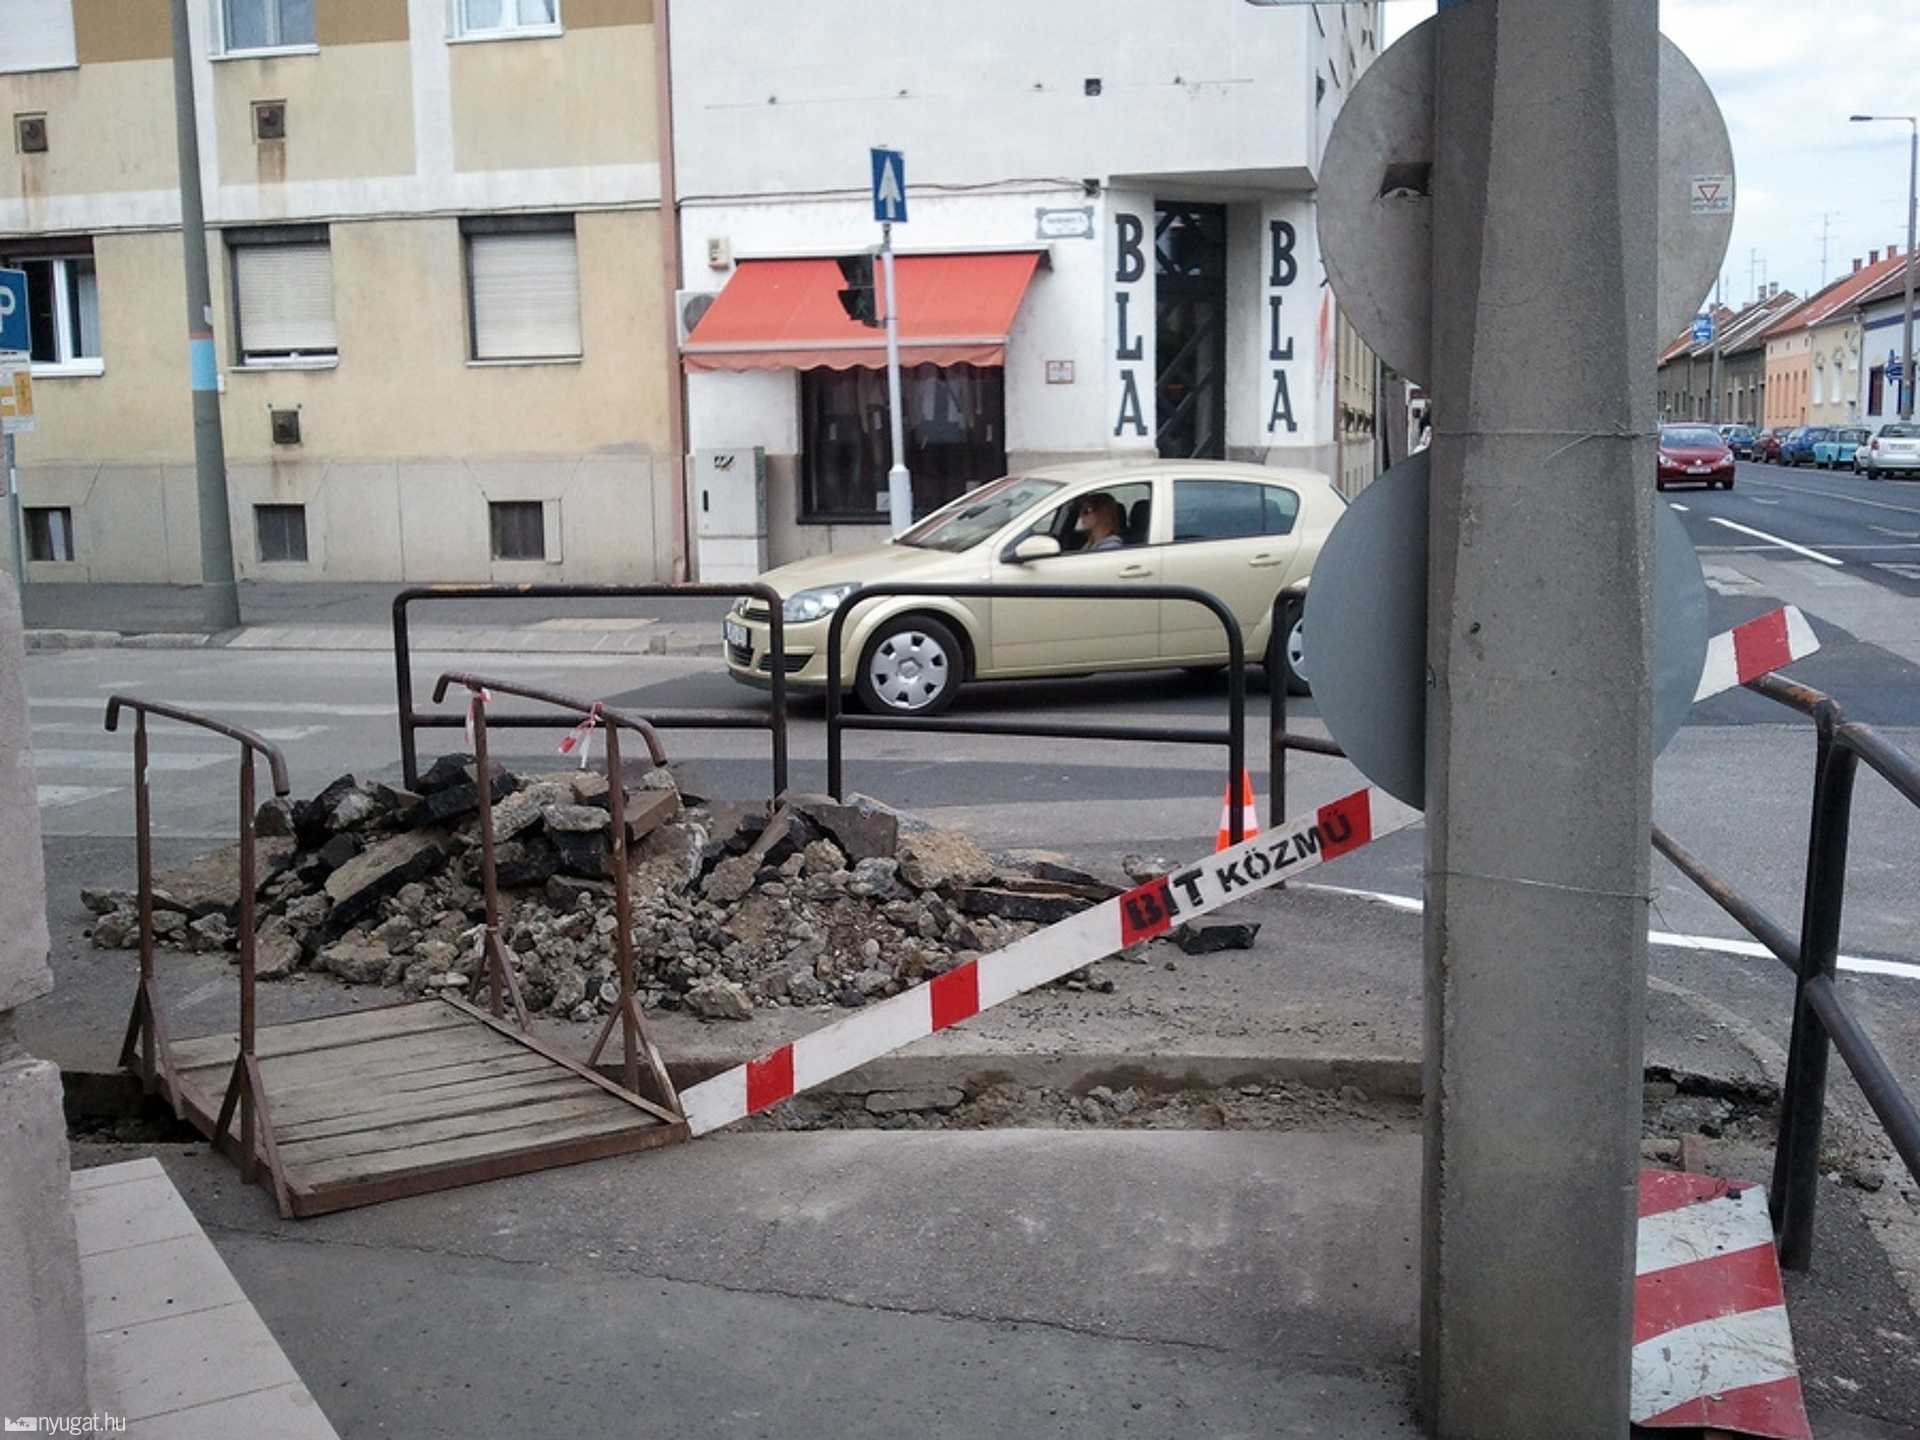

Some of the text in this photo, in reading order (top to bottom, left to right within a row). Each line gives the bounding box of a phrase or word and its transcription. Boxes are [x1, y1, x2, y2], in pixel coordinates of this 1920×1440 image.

[1114, 213, 1148, 436] BLA
[1267, 220, 1298, 432] BLA
[1126, 868, 1204, 931] BIT
